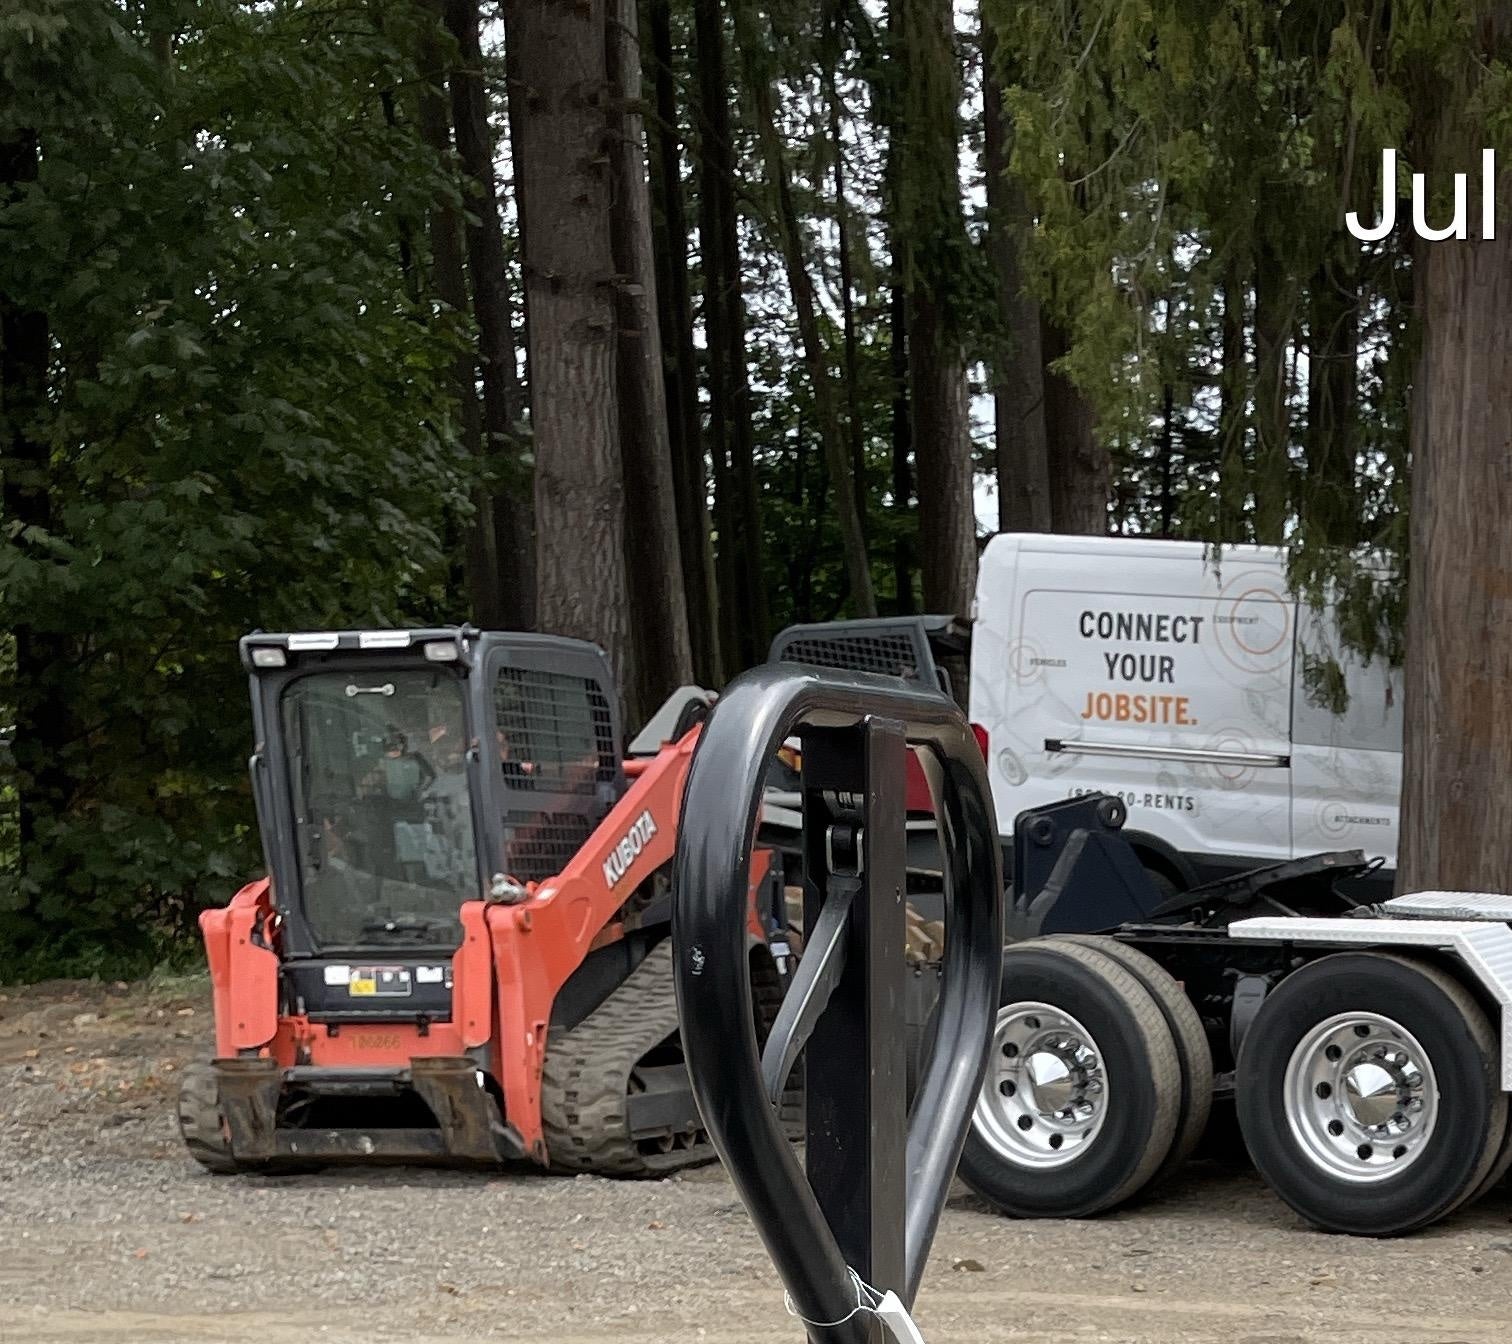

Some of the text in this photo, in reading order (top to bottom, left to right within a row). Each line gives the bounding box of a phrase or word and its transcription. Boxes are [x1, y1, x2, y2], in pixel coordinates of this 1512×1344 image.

[1079, 611, 1204, 644] CONNECT
[1104, 652, 1175, 684] YOUR
[1081, 692, 1198, 725] JOBSITE.
[602, 809, 657, 890] KUBOTA
